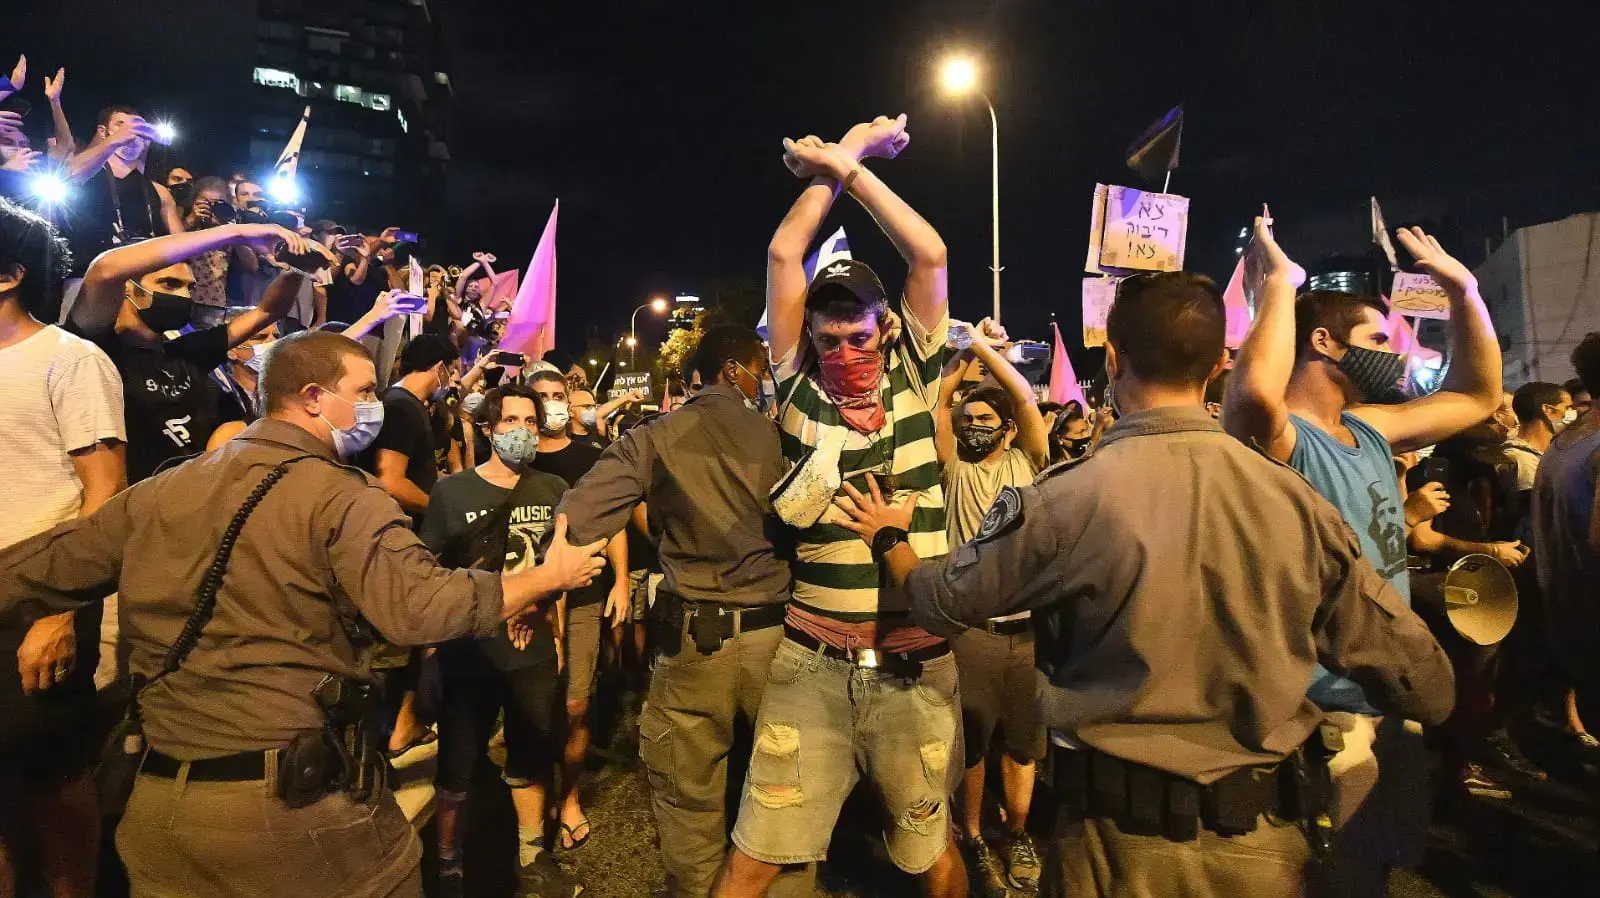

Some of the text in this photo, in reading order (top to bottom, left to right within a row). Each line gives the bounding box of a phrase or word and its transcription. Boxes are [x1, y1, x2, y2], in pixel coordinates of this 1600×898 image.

[1138, 202, 1164, 221] צא
[1126, 221, 1169, 240] דיבוק
[1127, 241, 1156, 260] צא!
[508, 505, 552, 524] MUSIC
